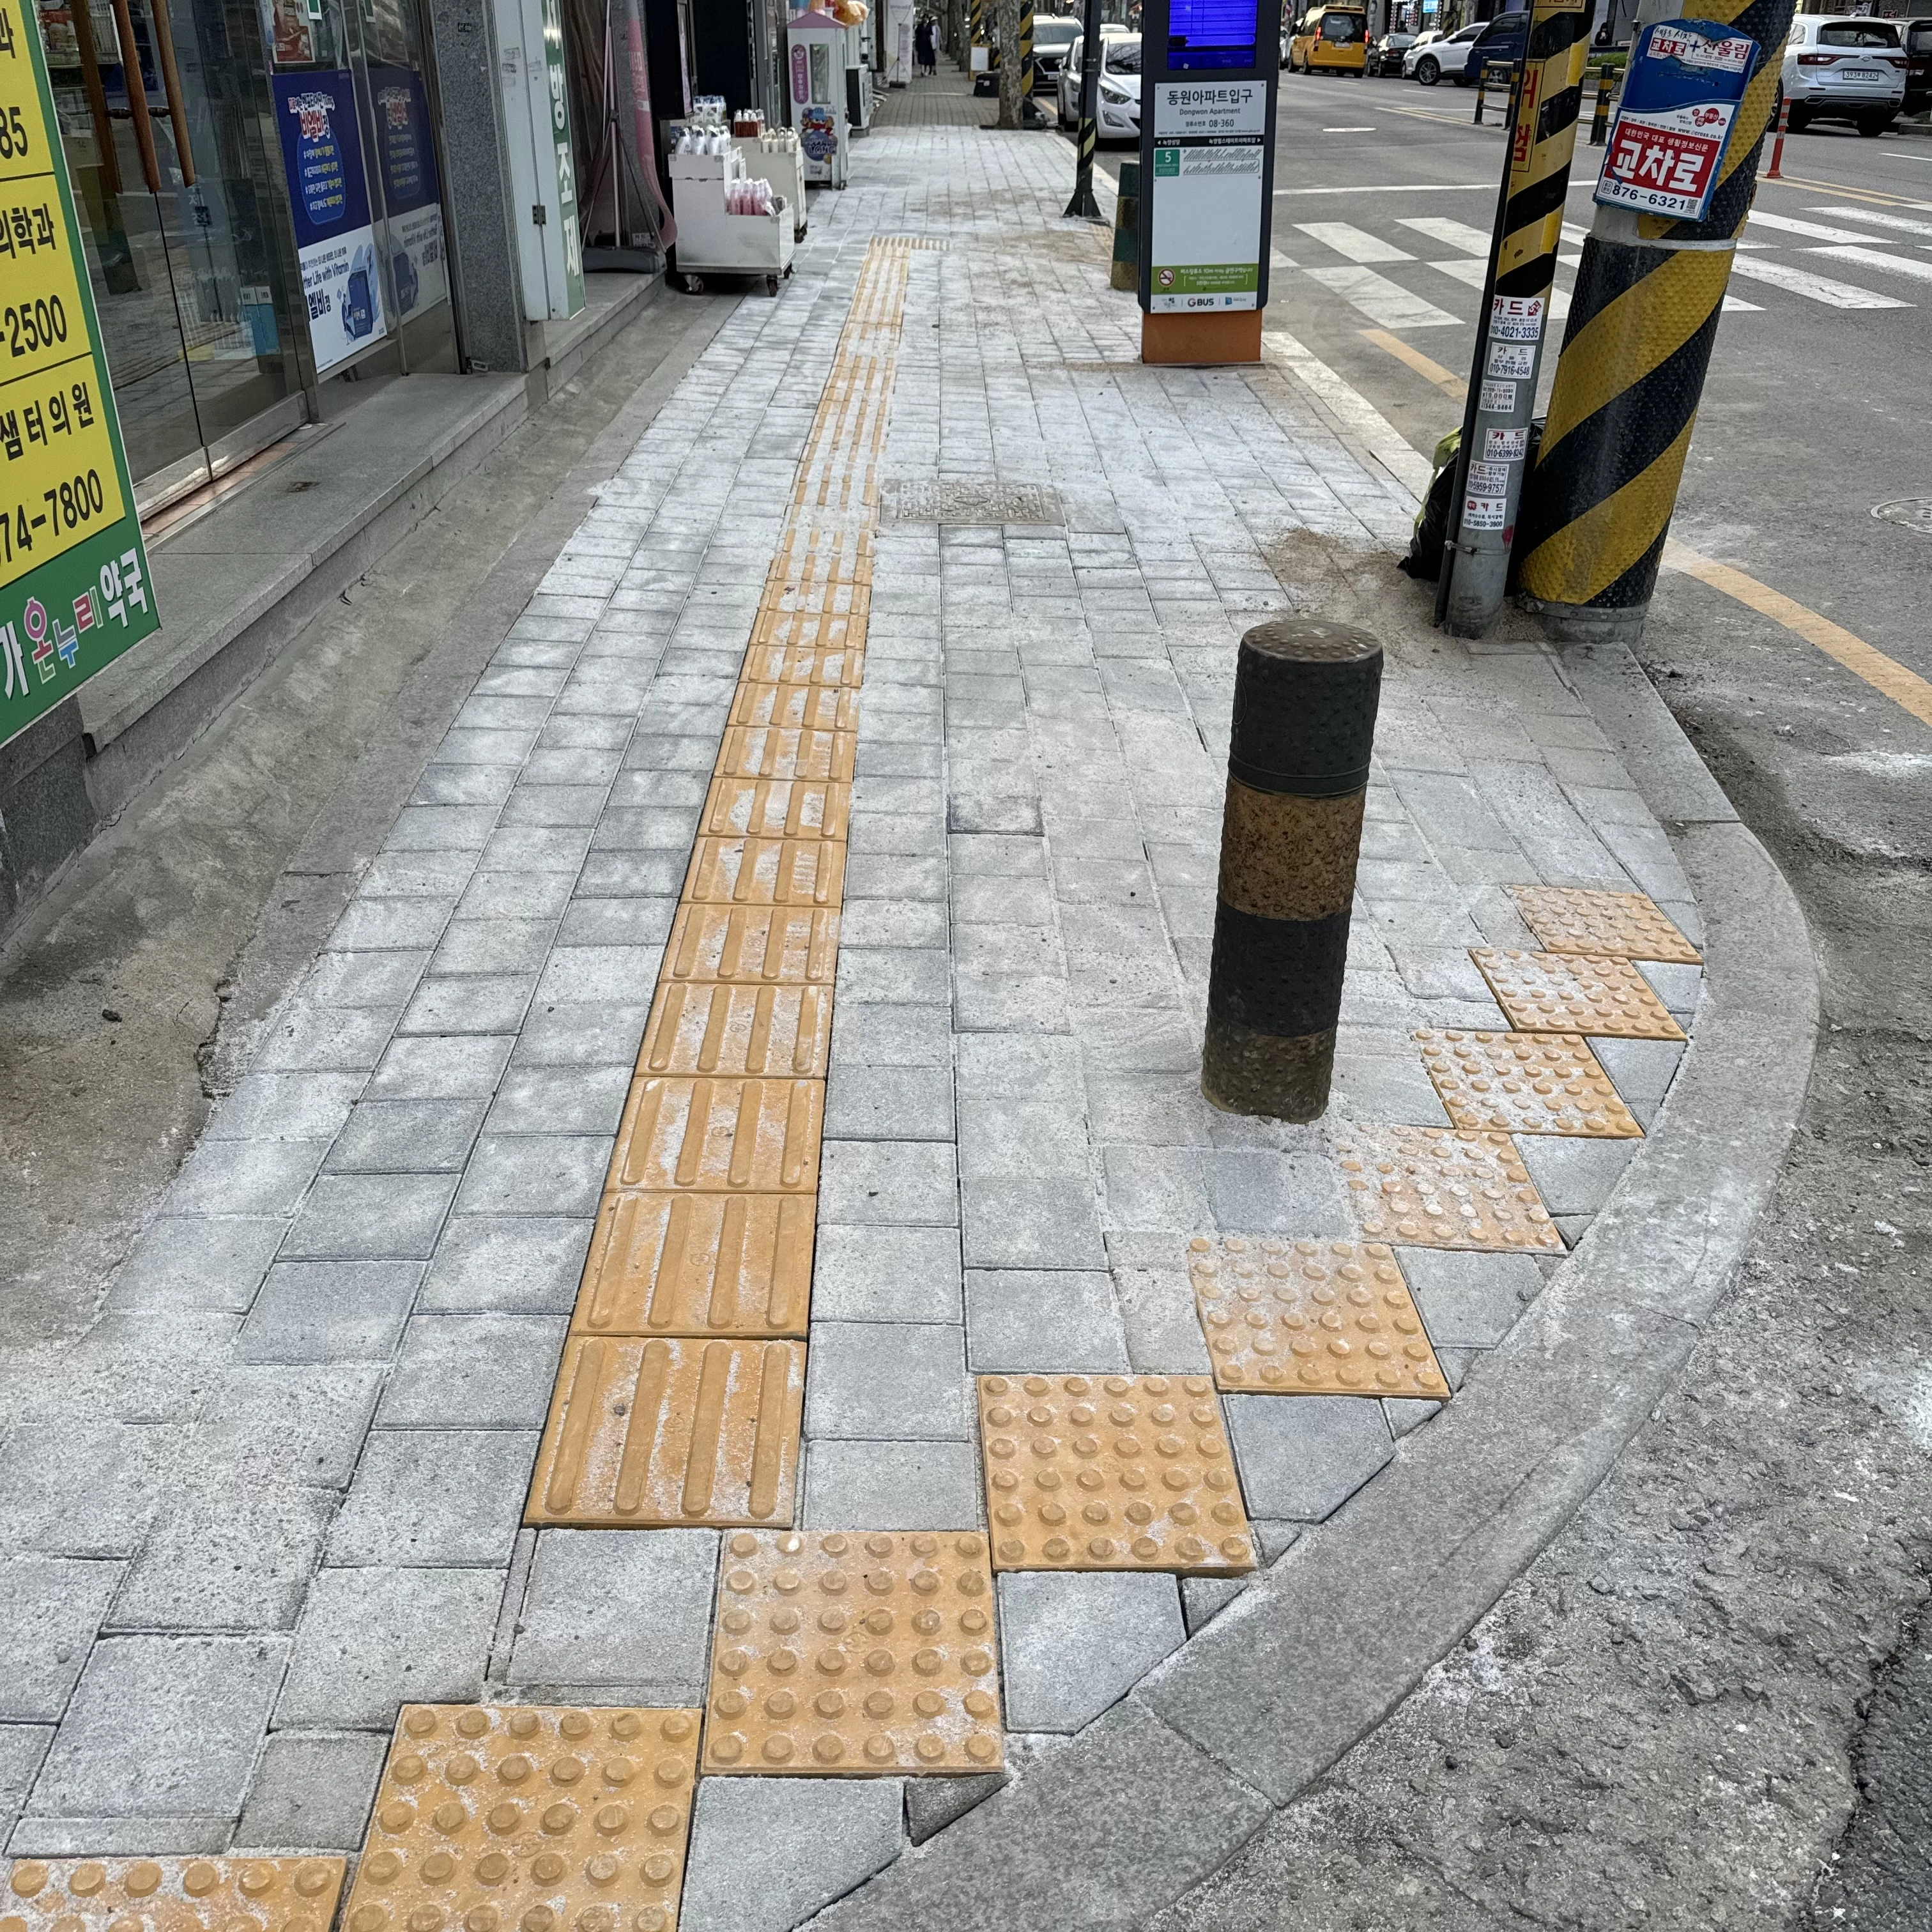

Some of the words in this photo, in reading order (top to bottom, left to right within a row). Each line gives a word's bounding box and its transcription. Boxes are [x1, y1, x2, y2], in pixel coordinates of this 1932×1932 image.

[1651, 38, 1686, 56] 교차로
[1703, 40, 1750, 60] 산울림
[1167, 89, 1254, 106] 동원아파트입구
[1208, 119, 1234, 128] 08-360
[1625, 128, 1650, 140] 대한민국
[1651, 134, 1665, 144] 대표
[1667, 137, 1709, 153] 생활정보신문
[1165, 151, 1172, 163] 5
[1613, 139, 1705, 192] 교차로
[1612, 185, 1686, 210] 876-6321
[312, 270, 322, 285] Life
[322, 265, 332, 281] with
[332, 259, 349, 277] Vitamin
[306, 288, 331, 321] 엘비정
[0, 381, 95, 461] 샘터의원
[1471, 463, 1486, 475] 카드
[1480, 502, 1503, 512] 카드
